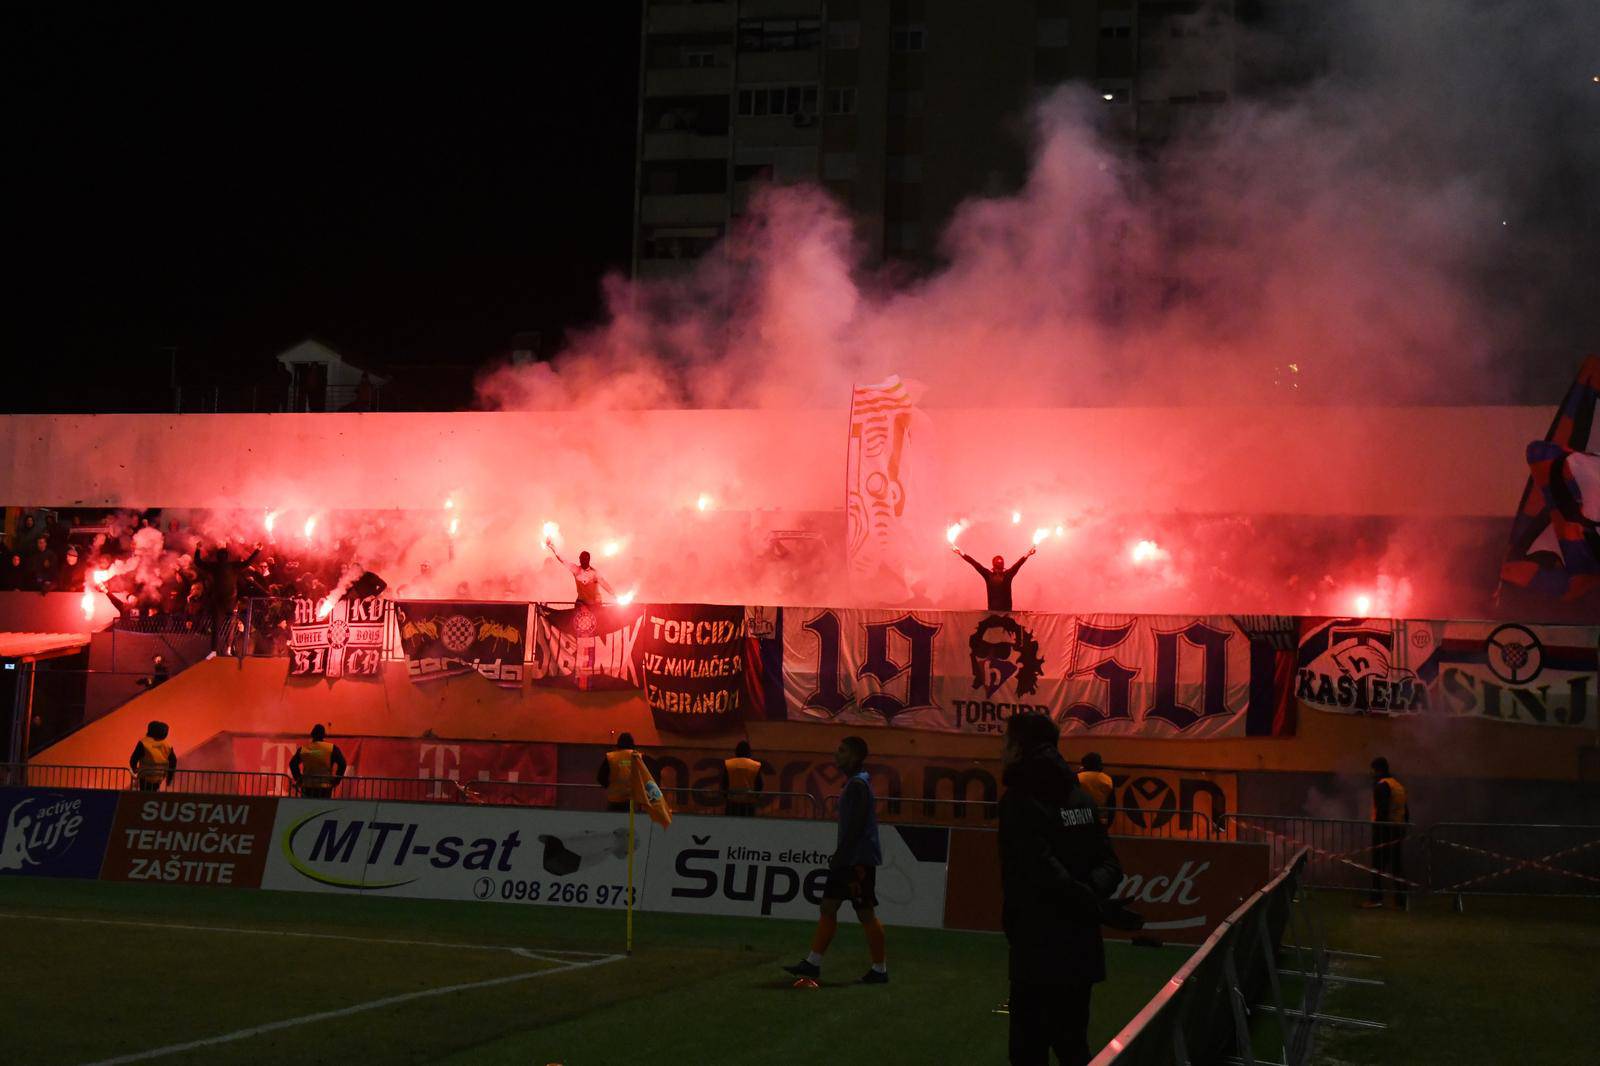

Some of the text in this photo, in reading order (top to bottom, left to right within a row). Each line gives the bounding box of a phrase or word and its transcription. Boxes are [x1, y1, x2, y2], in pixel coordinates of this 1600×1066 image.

[295, 631, 323, 644] WHITE
[356, 630, 380, 644] BOYS
[645, 651, 663, 674] UZ
[36, 799, 82, 820] active
[141, 801, 250, 825] SUSTAVI
[125, 827, 255, 855] TEHNIČKE
[308, 820, 521, 872] MTI-sat
[727, 846, 771, 861] klima
[128, 855, 235, 883] ZAŠTITE
[671, 834, 833, 916] Šupe
[501, 879, 541, 900] 098
[548, 882, 588, 903] 266
[1108, 858, 1211, 905] nck
